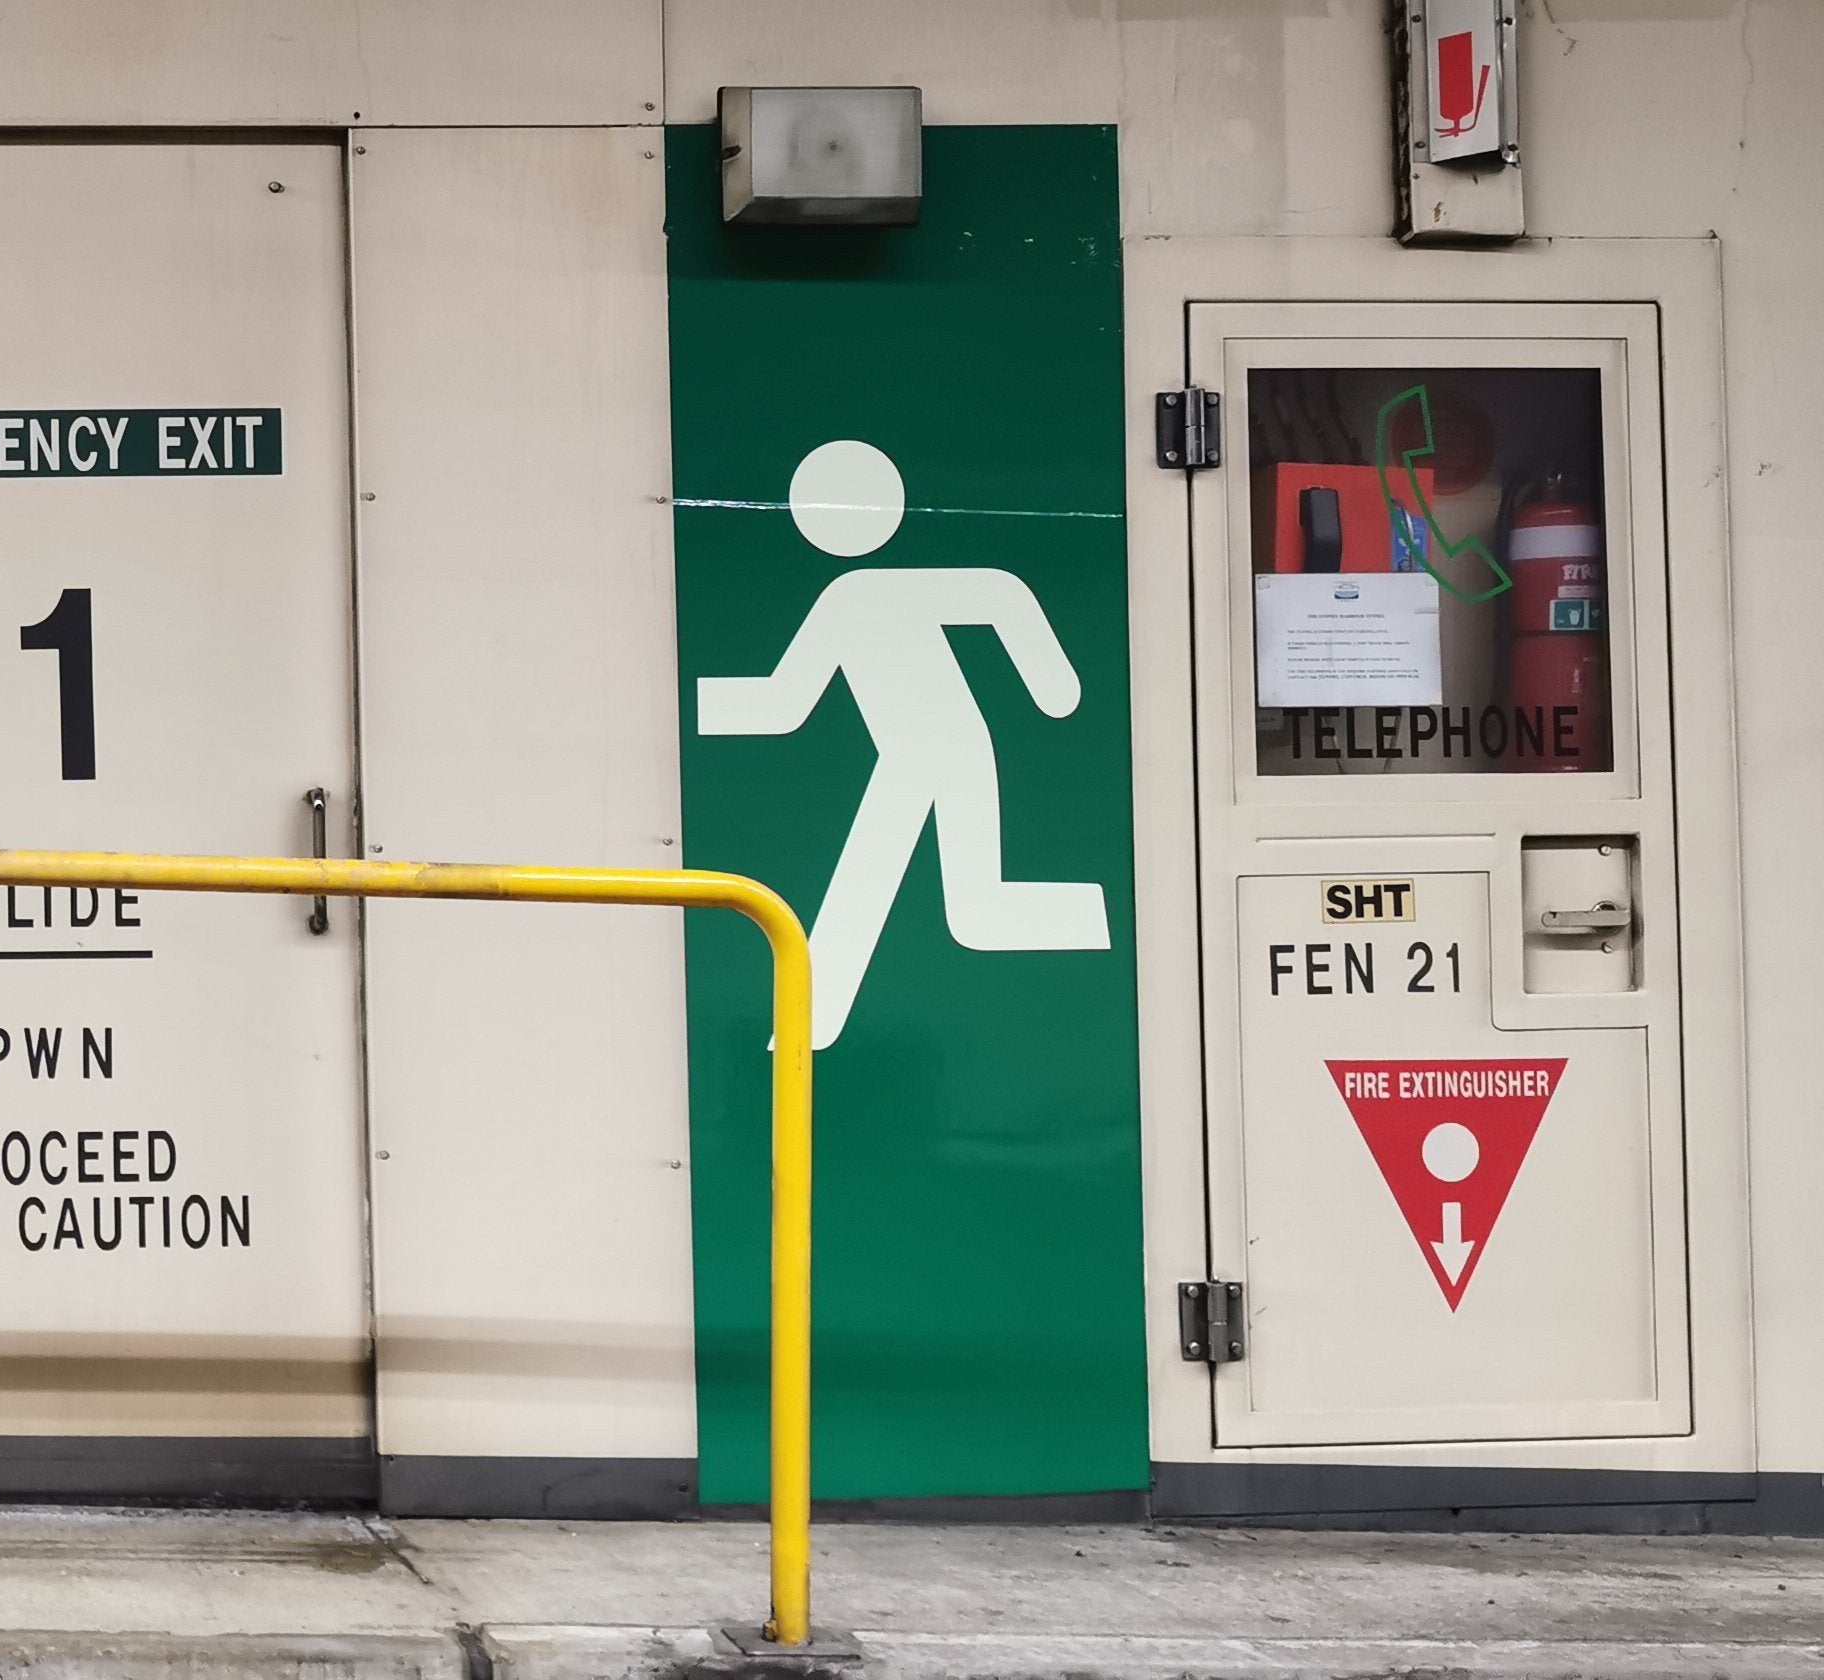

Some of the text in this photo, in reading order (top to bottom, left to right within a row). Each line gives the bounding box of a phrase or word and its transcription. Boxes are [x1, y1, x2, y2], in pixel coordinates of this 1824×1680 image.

[158, 416, 263, 469] EXIT
[1283, 705, 1580, 758] TELEPHONE
[1326, 884, 1411, 919] SHT
[1269, 941, 1461, 996] FEN 21
[1344, 1070, 1550, 1099] FIRE EXTINGUISHER
[18, 1194, 251, 1251] CAUTION
